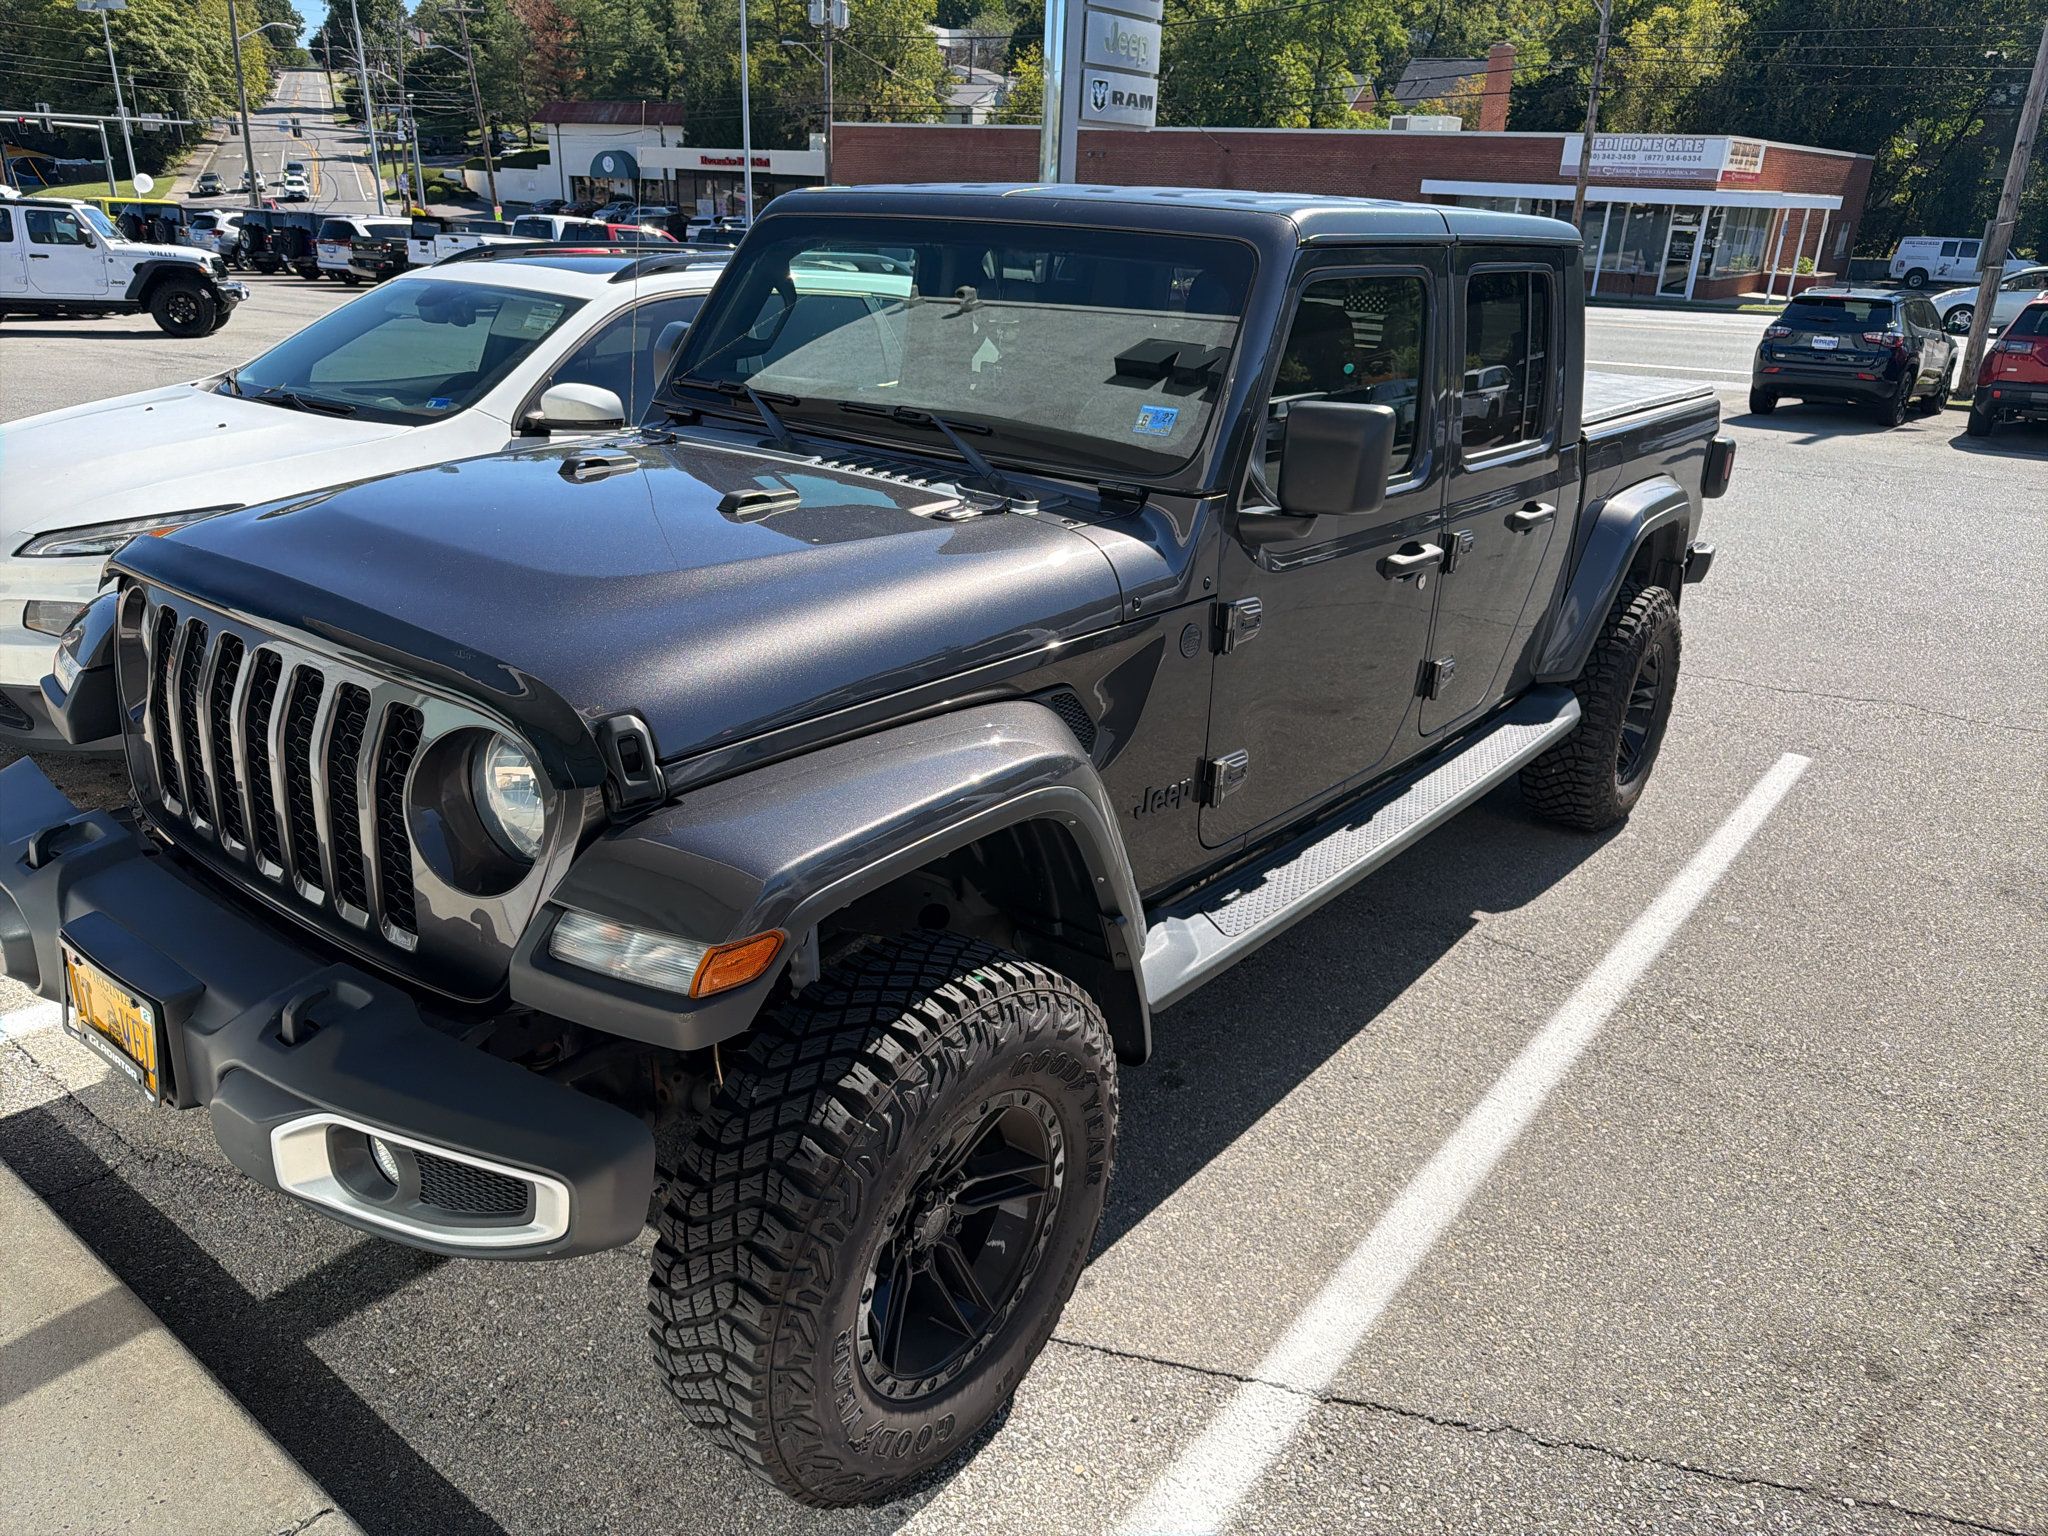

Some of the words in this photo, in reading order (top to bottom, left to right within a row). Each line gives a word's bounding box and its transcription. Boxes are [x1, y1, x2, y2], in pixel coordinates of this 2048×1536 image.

[1104, 21, 1149, 68] Jeep
[1112, 90, 1154, 111] RAM
[1593, 138, 1619, 151] EDI
[1621, 137, 1663, 152] HOME
[1665, 138, 1706, 153] CARE
[1162, 412, 1175, 426] 27
[1133, 778, 1193, 820] Jeep
[88, 1033, 138, 1083] GLADIATOR
